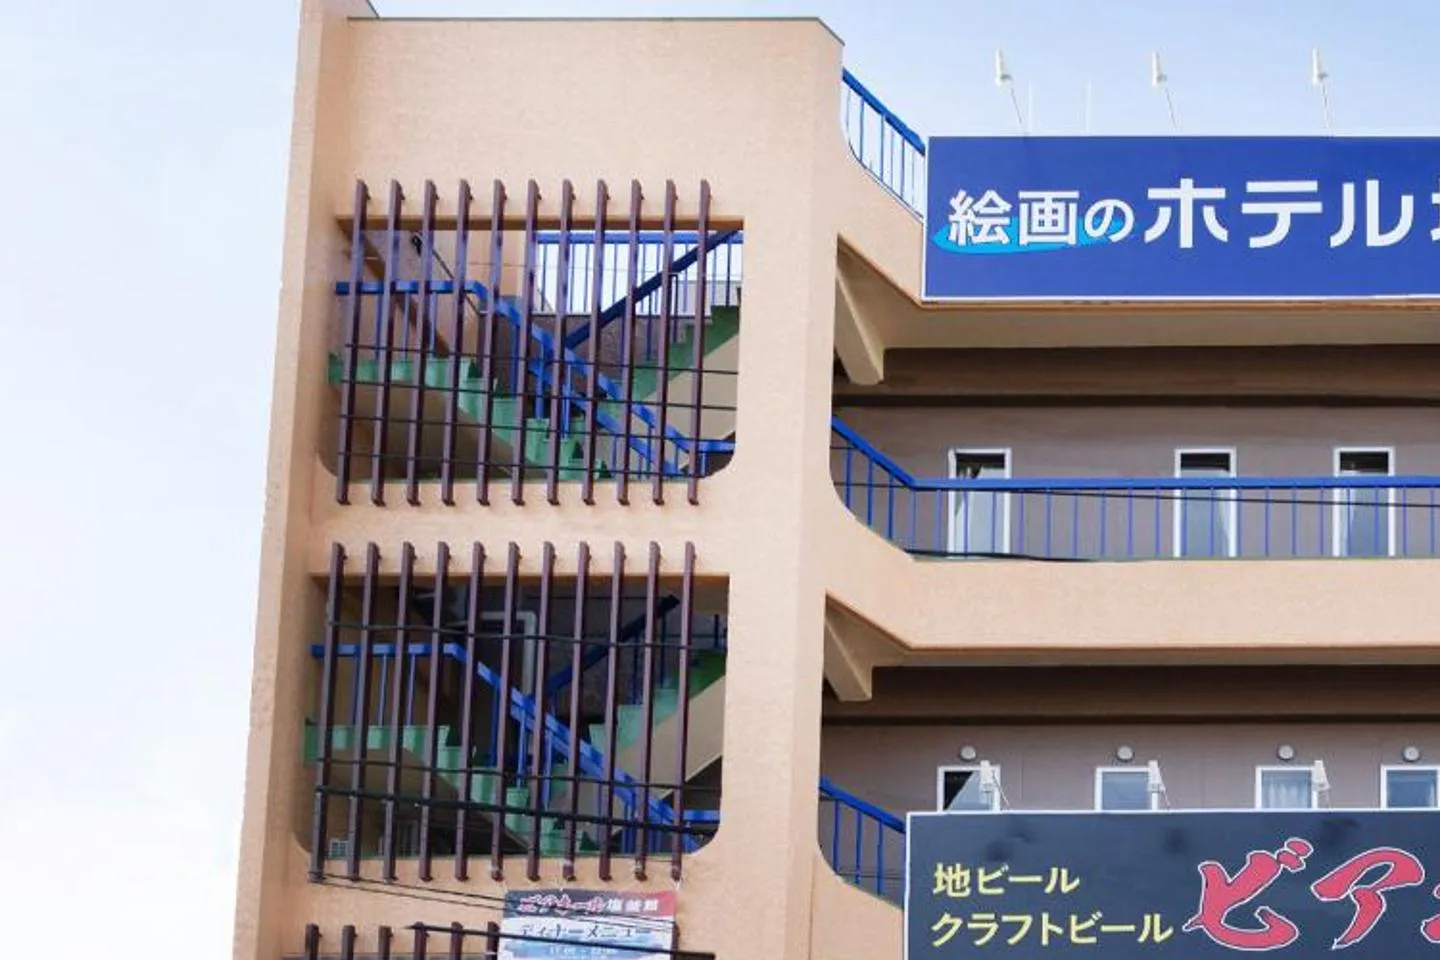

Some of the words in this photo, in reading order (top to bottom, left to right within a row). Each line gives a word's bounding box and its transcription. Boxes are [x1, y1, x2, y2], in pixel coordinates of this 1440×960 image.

[932, 863, 1081, 896] 地ビール
[931, 912, 1174, 947] クラフトビール
